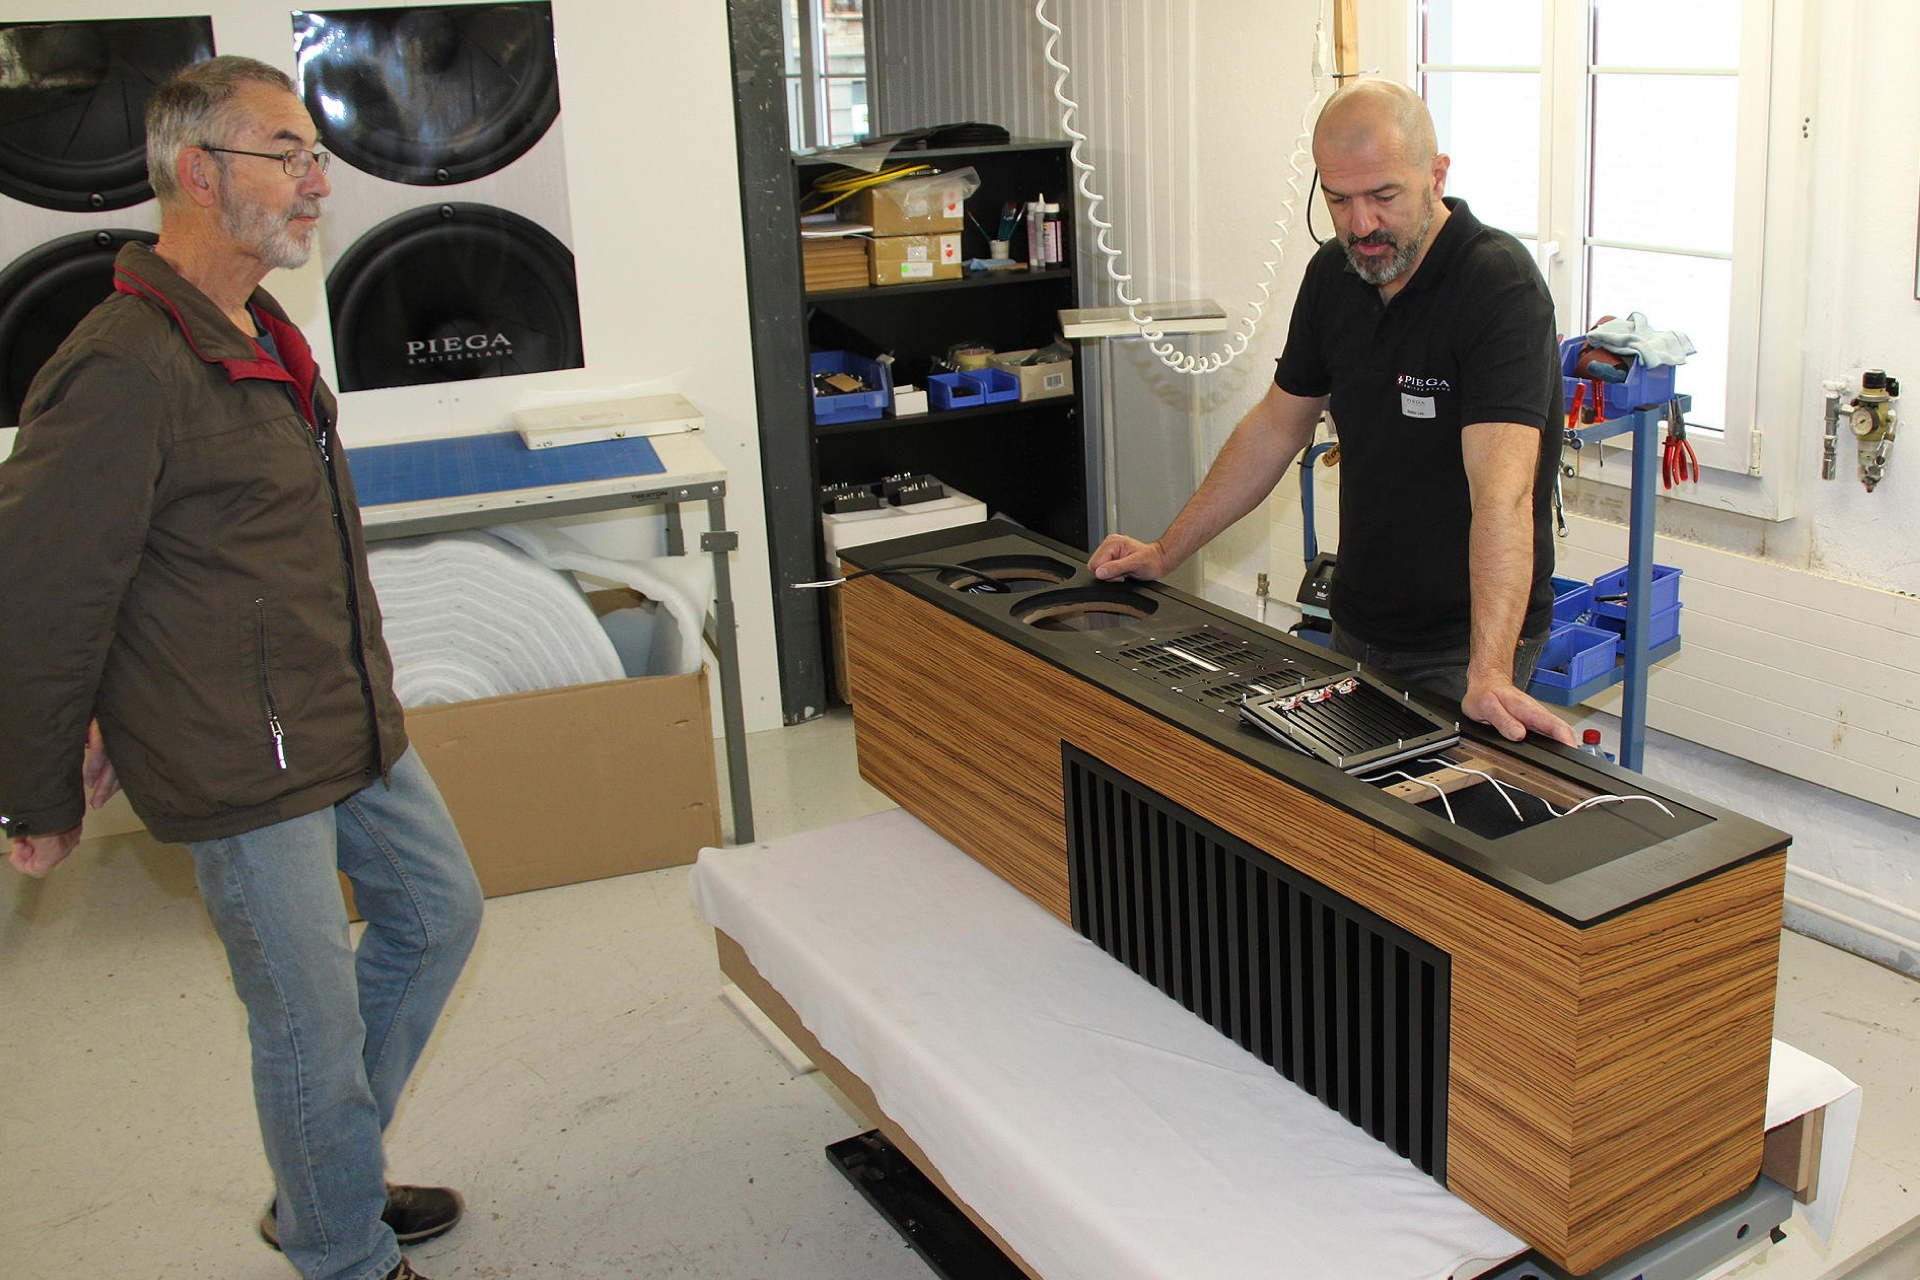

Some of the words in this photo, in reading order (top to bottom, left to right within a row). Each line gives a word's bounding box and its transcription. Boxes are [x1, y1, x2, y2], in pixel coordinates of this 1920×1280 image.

[406, 332, 512, 355] PIEGA
[408, 348, 513, 365] SWITZERLAND
[1404, 375, 1450, 387] PIEGA
